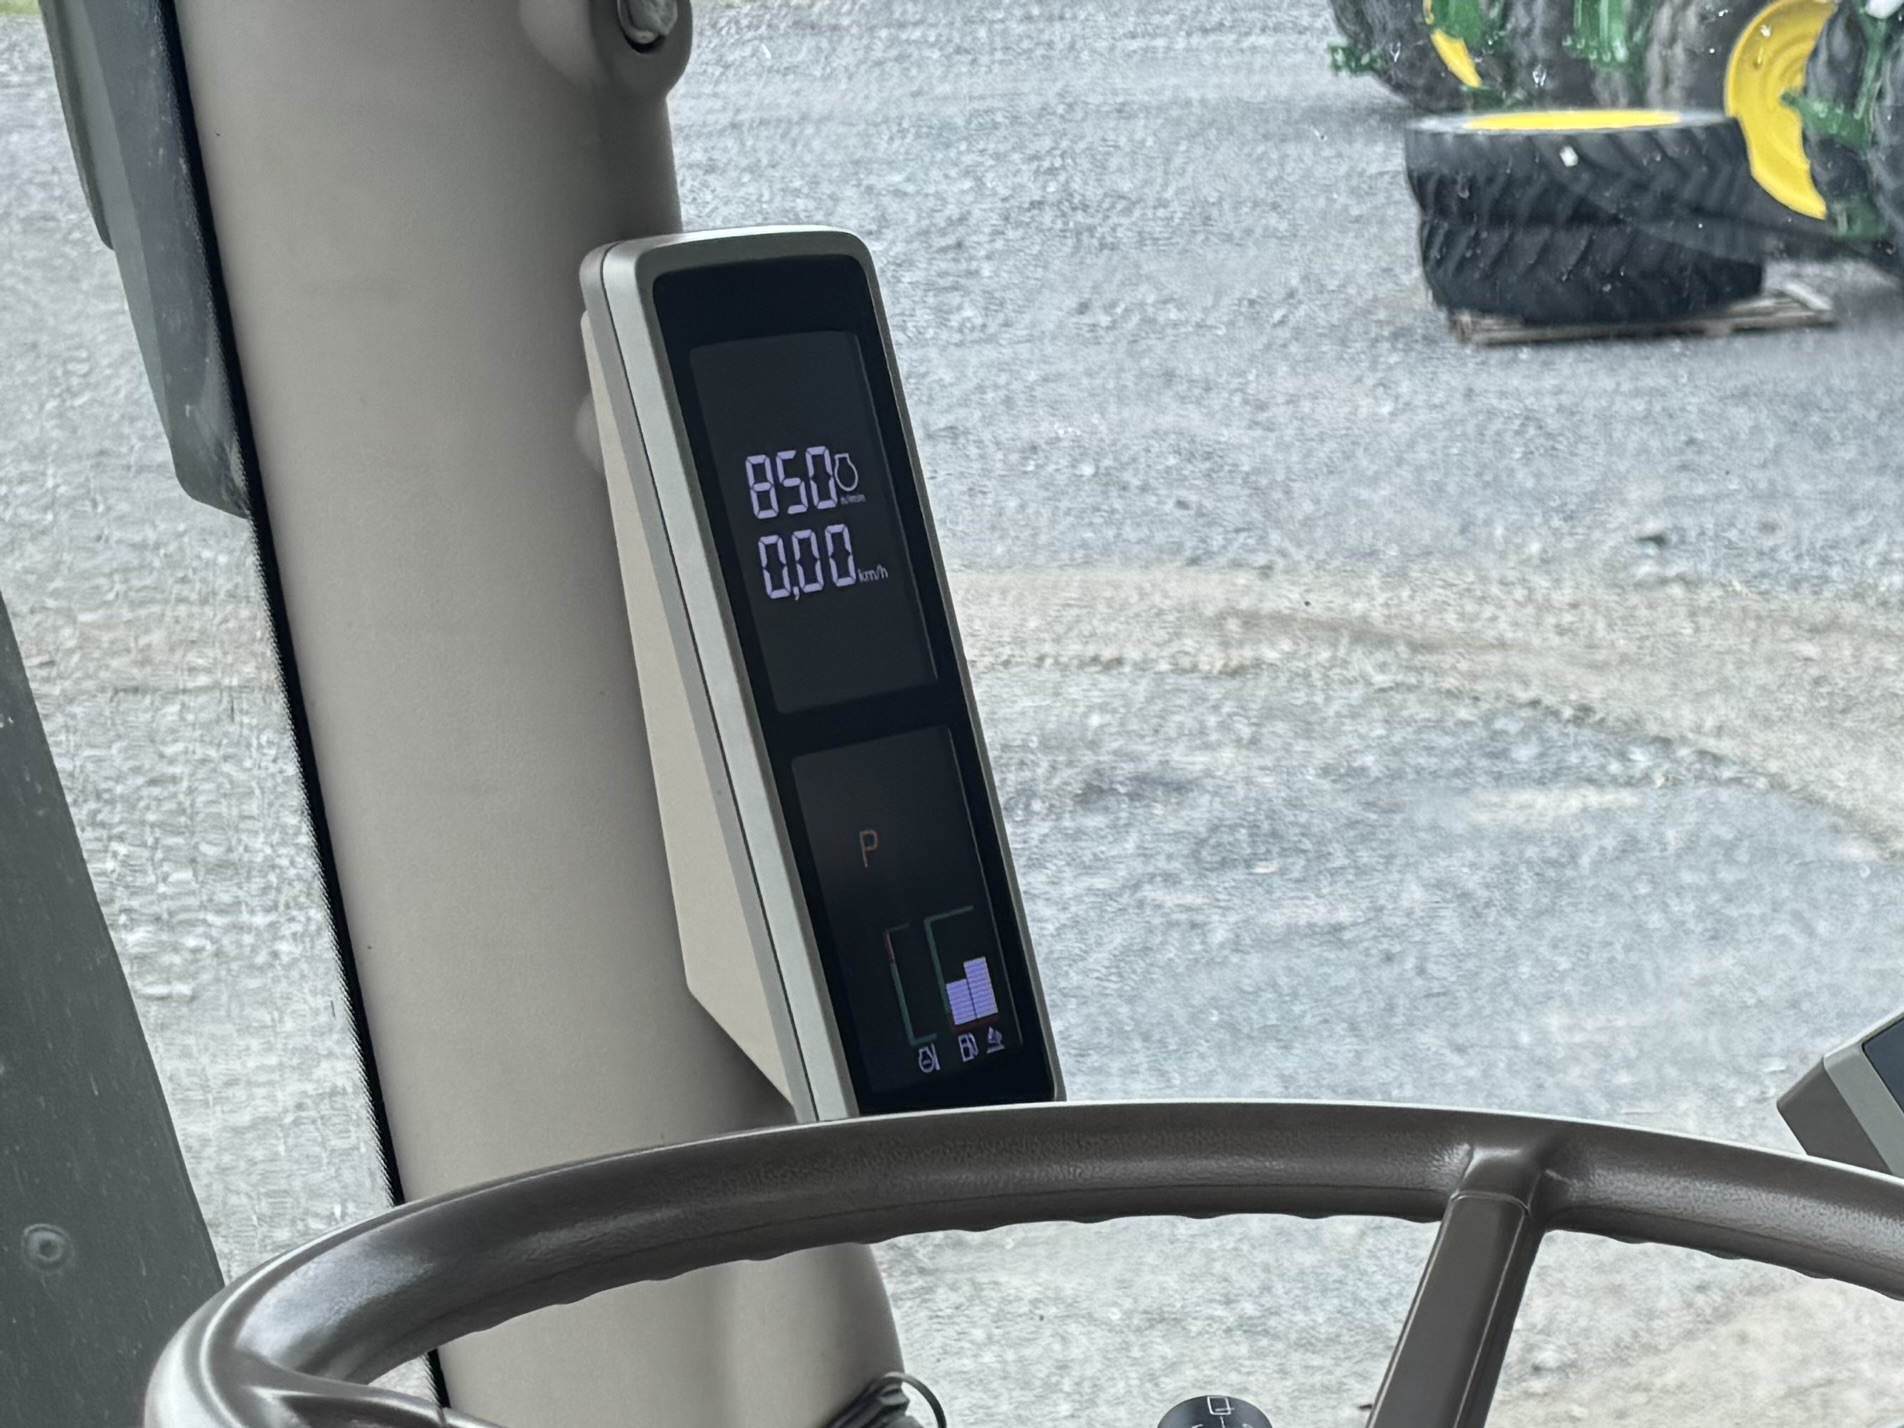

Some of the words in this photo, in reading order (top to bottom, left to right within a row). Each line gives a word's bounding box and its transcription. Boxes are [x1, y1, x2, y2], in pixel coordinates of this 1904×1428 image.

[745, 446, 838, 520] 850
[858, 563, 889, 583] km/h
[859, 829, 879, 868] P
